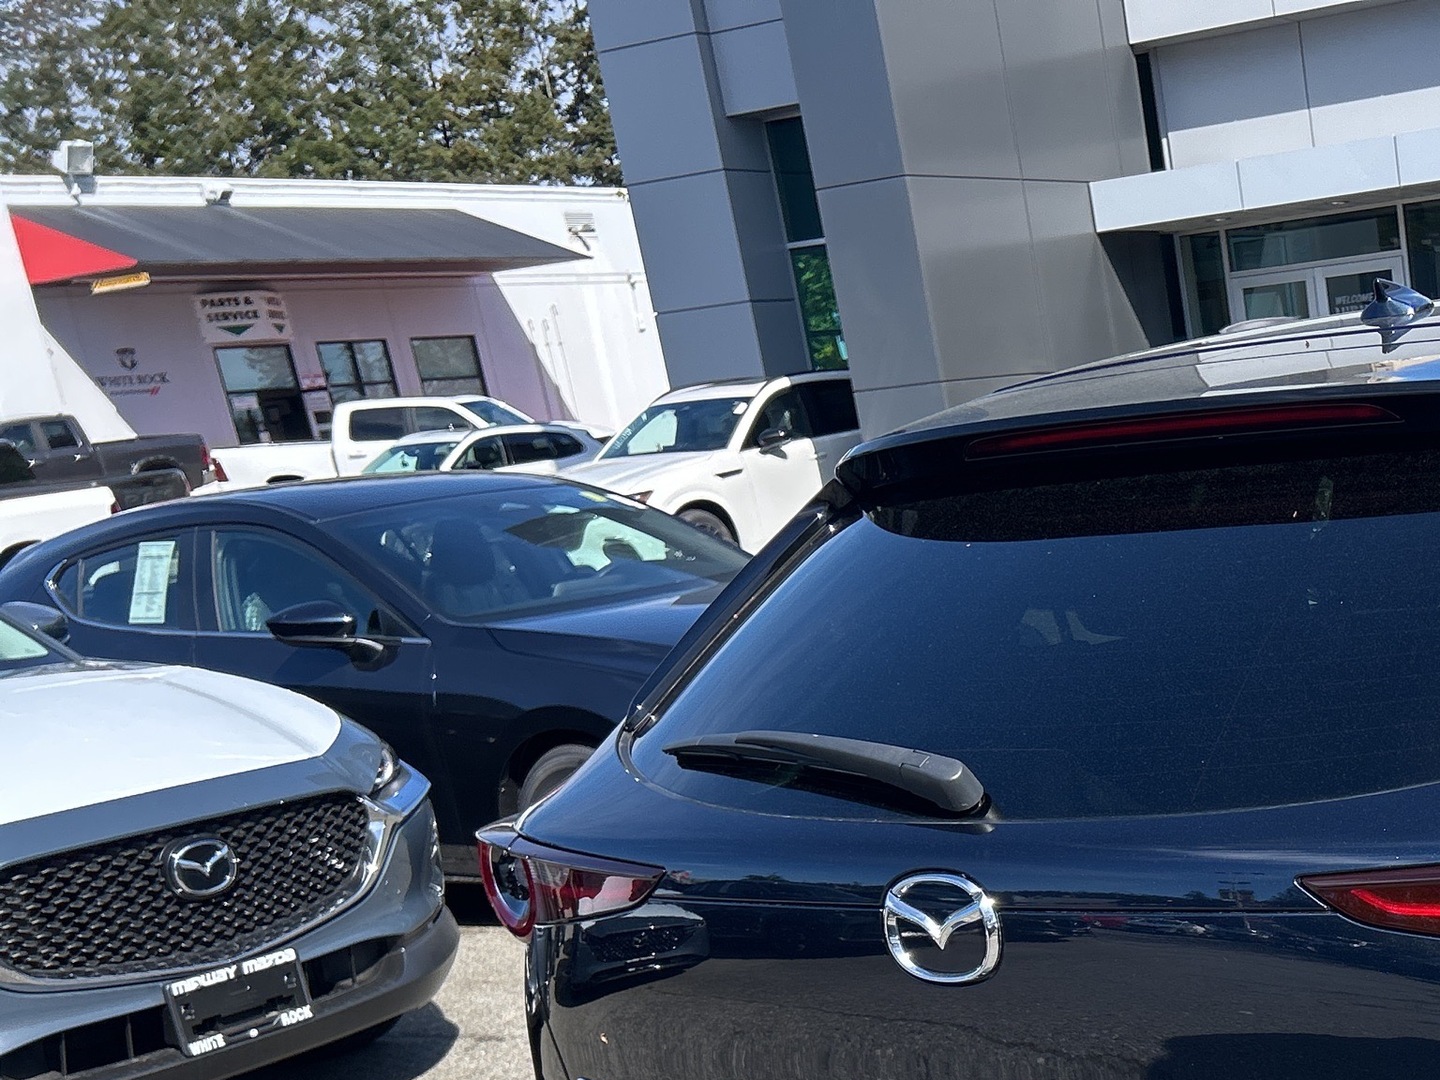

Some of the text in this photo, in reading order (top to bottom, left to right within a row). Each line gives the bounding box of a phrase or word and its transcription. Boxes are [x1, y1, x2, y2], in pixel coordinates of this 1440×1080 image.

[200, 297, 240, 309] PARTS
[206, 310, 260, 322] SERVICE
[188, 1004, 314, 1057] WHITE ROCK
